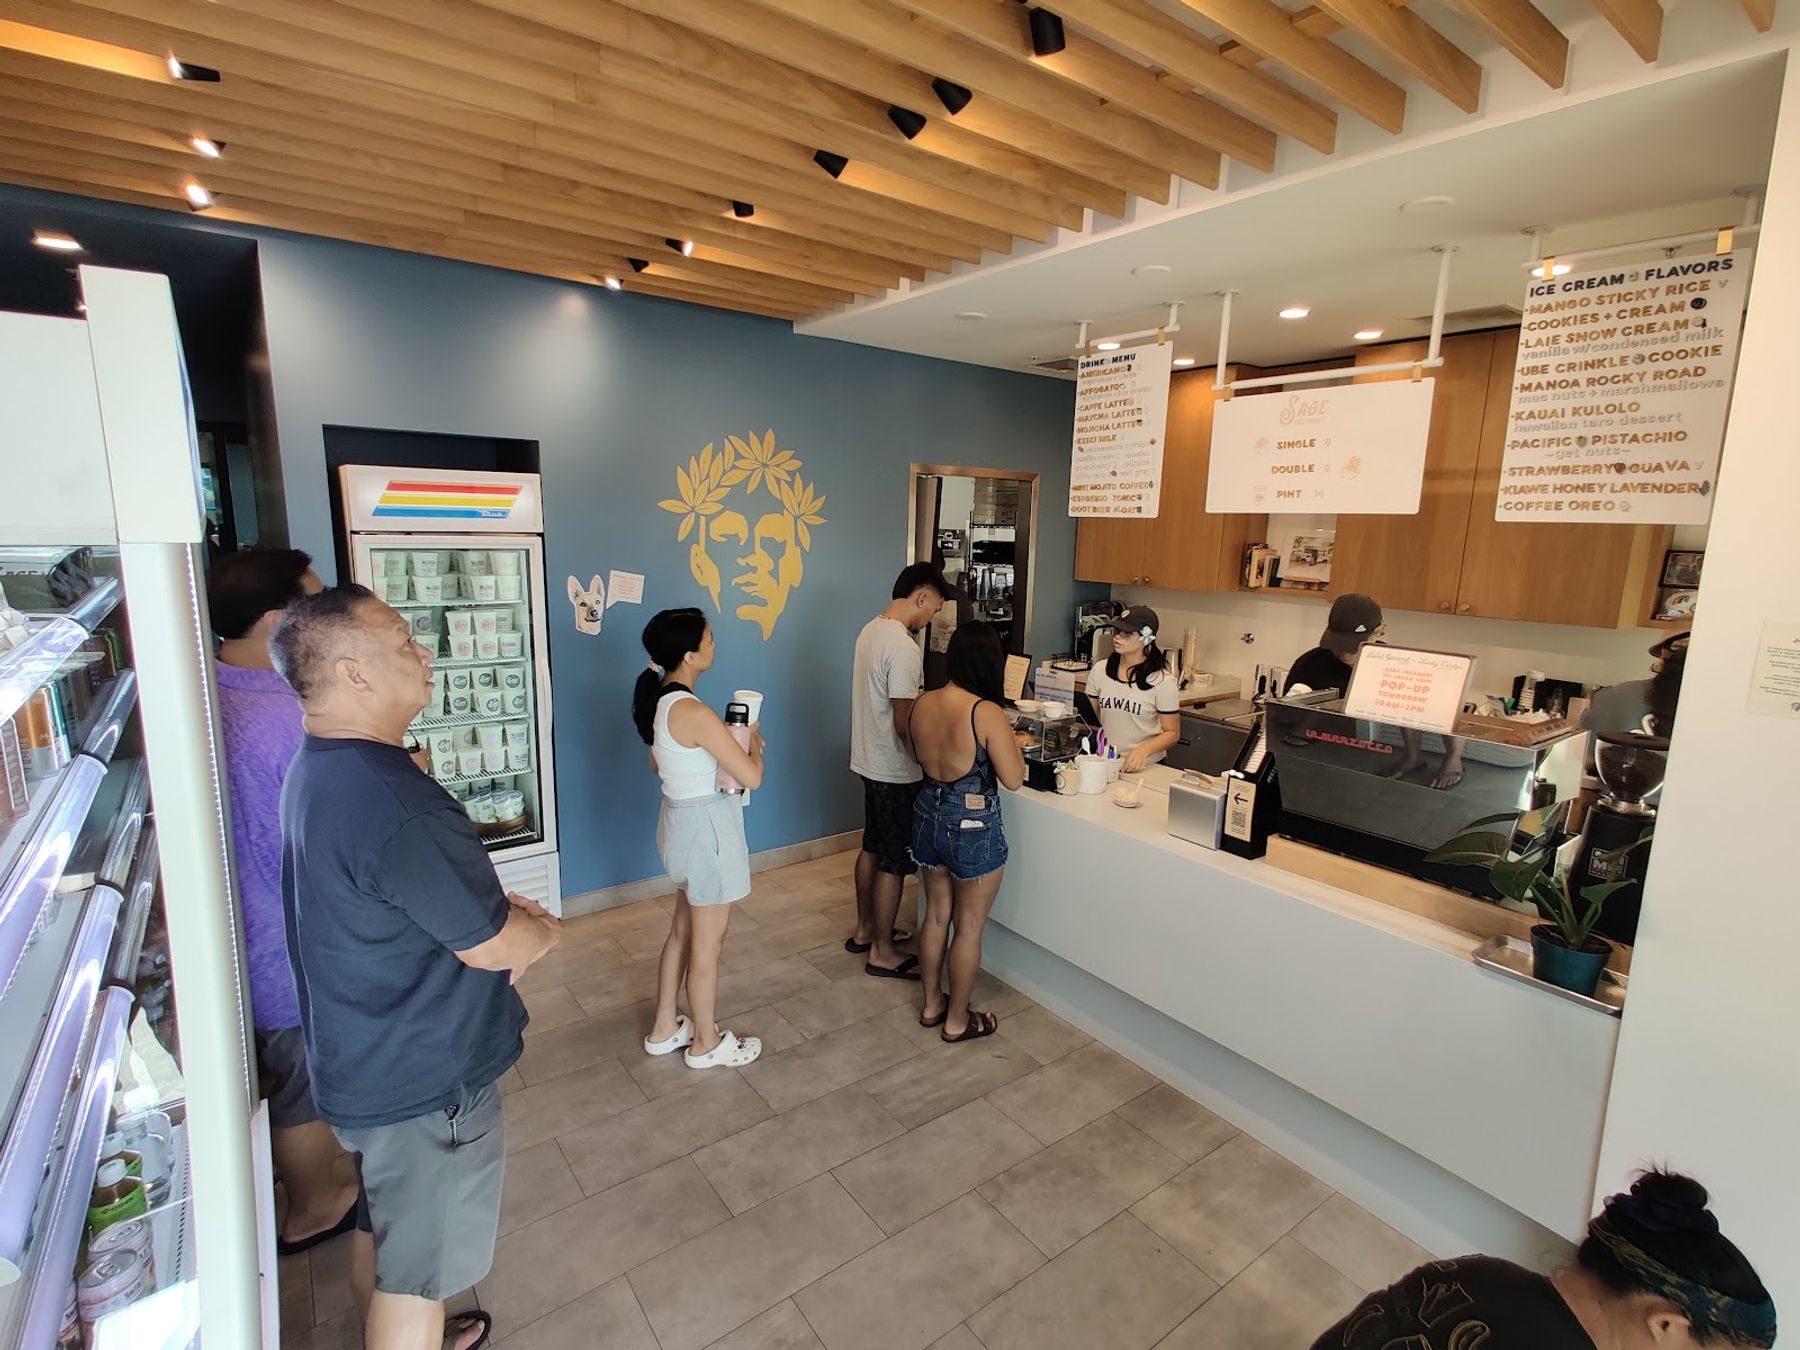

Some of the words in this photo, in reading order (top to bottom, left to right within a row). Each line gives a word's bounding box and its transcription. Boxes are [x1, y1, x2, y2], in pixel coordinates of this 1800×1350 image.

[1530, 284, 1556, 297] ICE
[1562, 273, 1625, 292] CREAM
[1645, 258, 1734, 280] FLAVORS
[1595, 287, 1660, 306] STICKY
[1665, 279, 1711, 296] RICE
[1616, 301, 1686, 320] CREAM
[1566, 328, 1618, 344] SNOW
[1621, 318, 1690, 337] CREAM
[1522, 346, 1570, 360] vanilla
[1684, 327, 1725, 341] milk
[1080, 358, 1105, 369] DRINK
[1111, 353, 1136, 364] MENU
[1555, 354, 1630, 374] CRINKLE
[1648, 345, 1724, 363] COOKIE
[1585, 371, 1648, 388] ROCKY
[1653, 364, 1707, 381] ROAD
[1517, 391, 1549, 405] mac
[1551, 387, 1586, 402] nuts
[1601, 378, 1725, 398] marshmallows
[1104, 399, 1129, 409] LATTE
[1572, 401, 1641, 418] KULOLO
[1111, 408, 1136, 419] LATTE
[1112, 420, 1136, 430] LATTE
[1513, 419, 1578, 433] hawaiian
[1582, 416, 1614, 428] taro
[1619, 411, 1683, 426] dessert
[1276, 438, 1316, 450] SINGLE
[1591, 430, 1688, 446] PISTACHIO
[1271, 463, 1316, 475] DOUBLE
[1628, 460, 1691, 474] GUAVA
[1276, 489, 1303, 499] PINT
[1552, 482, 1605, 494] HONEY
[1609, 481, 1699, 495] LAVENDER
[1568, 499, 1616, 511] OREO
[1380, 679, 1430, 694] POP-UP
[1378, 690, 1428, 703] TOMORROW
[1099, 697, 1142, 716] HAWAII
